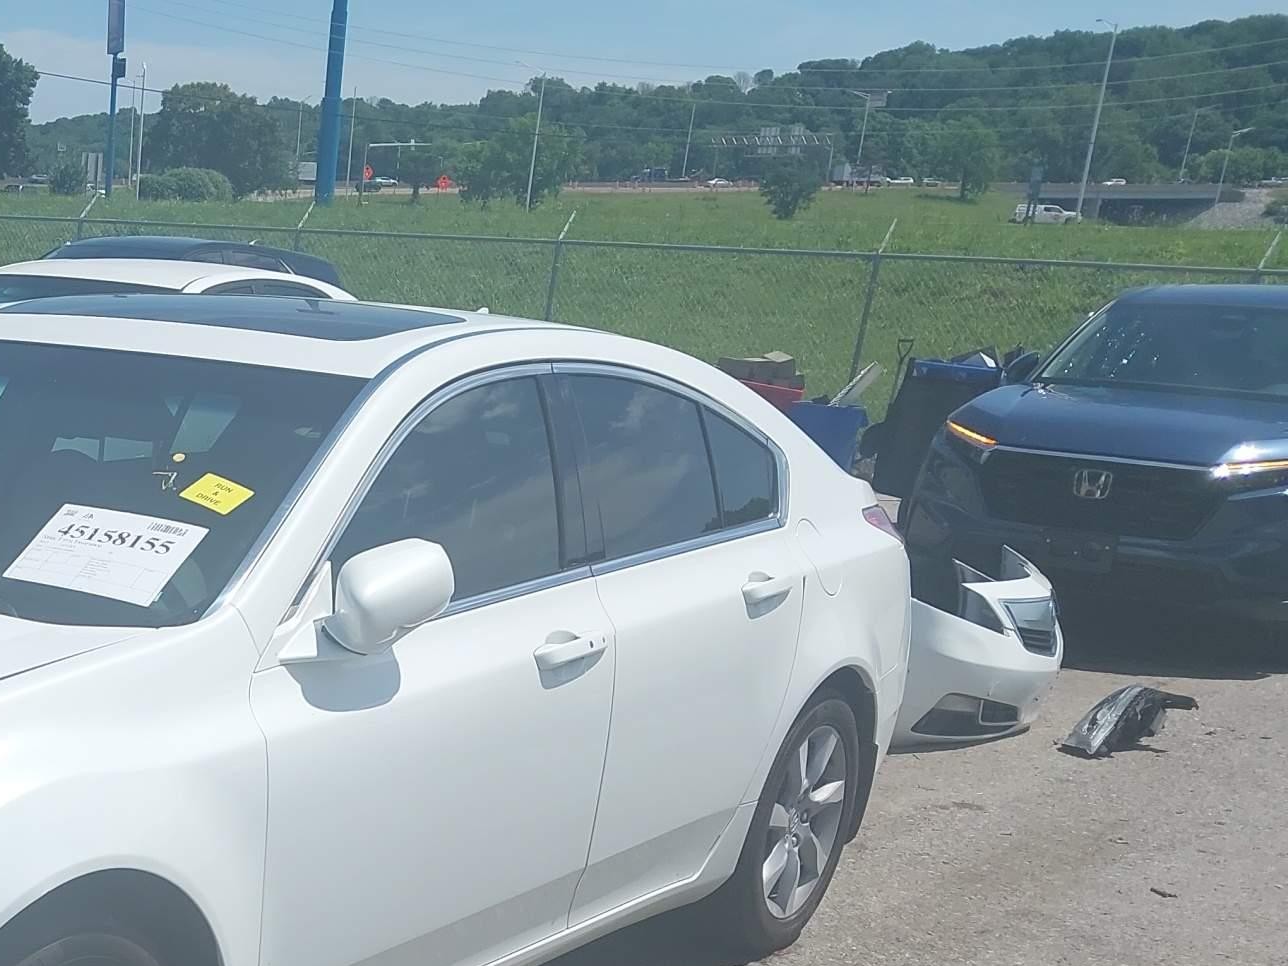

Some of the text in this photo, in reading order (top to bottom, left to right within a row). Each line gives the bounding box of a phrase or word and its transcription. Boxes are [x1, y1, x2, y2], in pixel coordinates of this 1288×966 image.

[214, 482, 234, 493] RUN
[195, 492, 222, 506] DRIVE
[57, 523, 176, 555] 45158155
